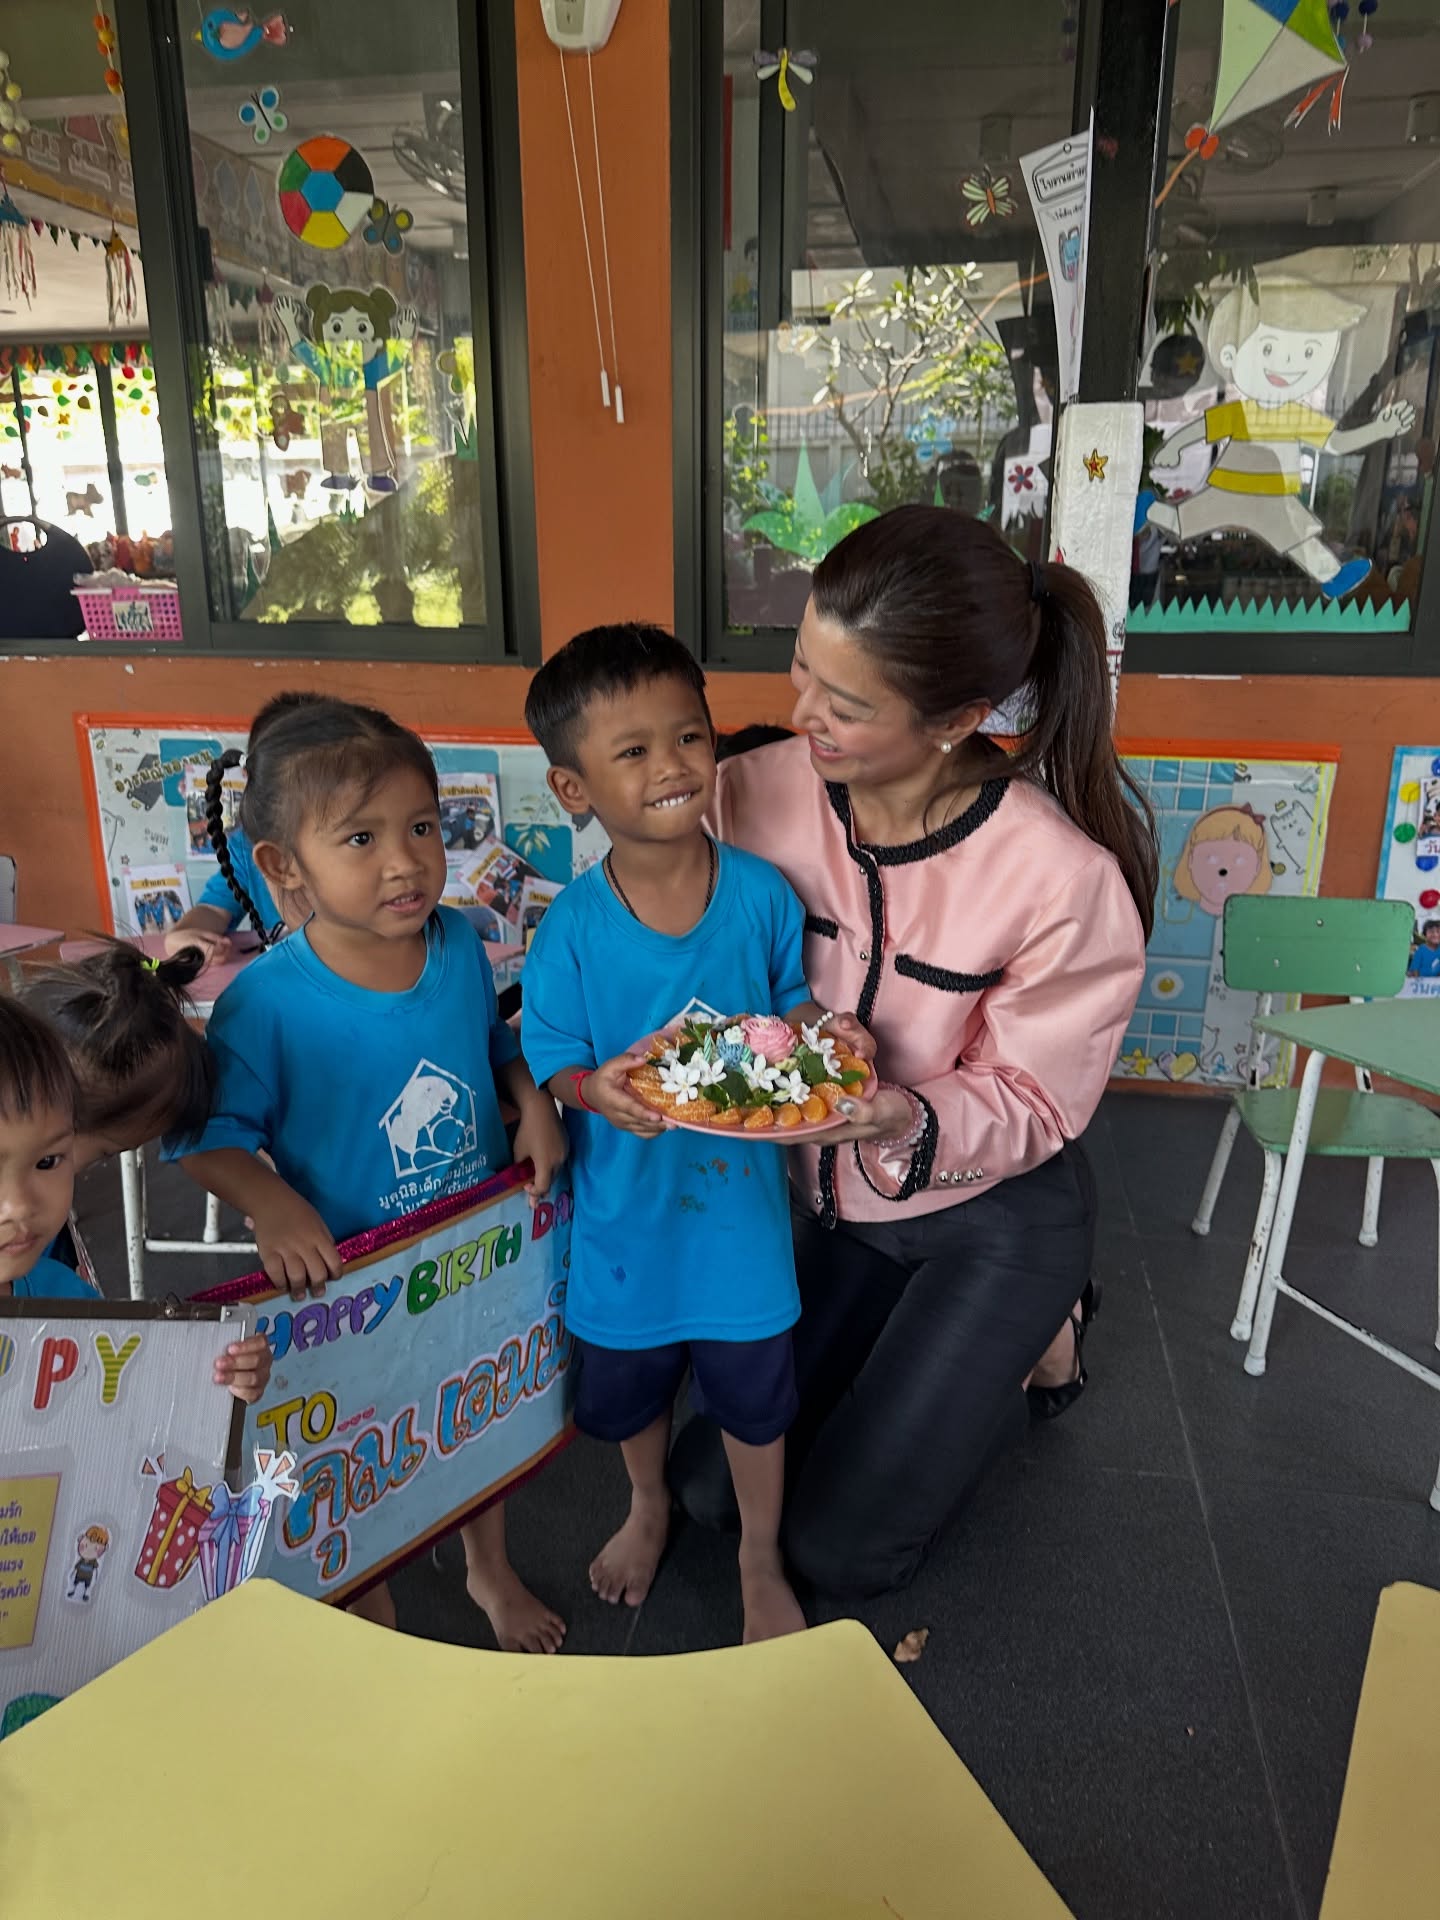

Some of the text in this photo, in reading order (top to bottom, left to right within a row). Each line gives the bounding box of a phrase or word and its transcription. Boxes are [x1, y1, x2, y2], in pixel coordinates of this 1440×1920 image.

[256, 1189, 575, 1361] HAPPY BIRTH DA
